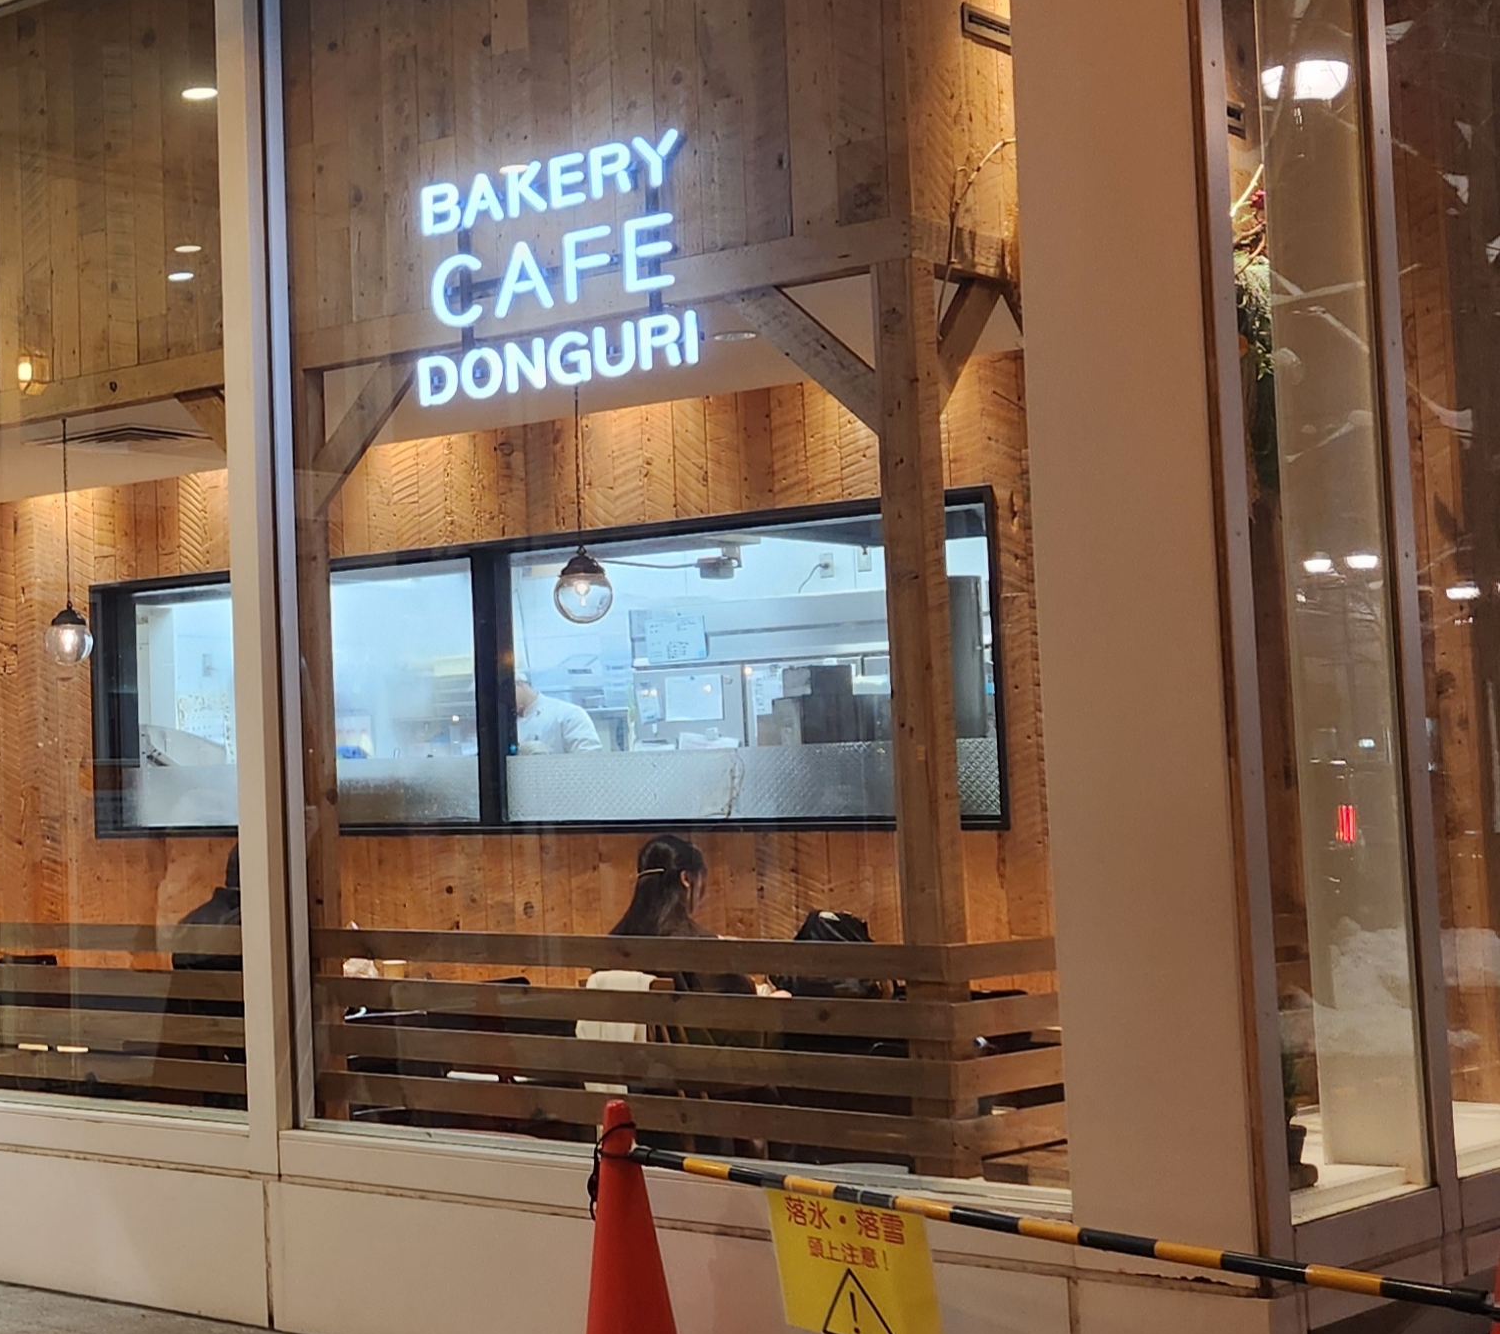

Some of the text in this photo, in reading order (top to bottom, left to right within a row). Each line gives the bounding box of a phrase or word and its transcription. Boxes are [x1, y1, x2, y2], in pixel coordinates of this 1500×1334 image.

[420, 128, 681, 237] BAKERY
[430, 211, 676, 329] CAFE
[417, 309, 703, 408] DONGURI
[784, 1196, 905, 1246] 落氷・落雪
